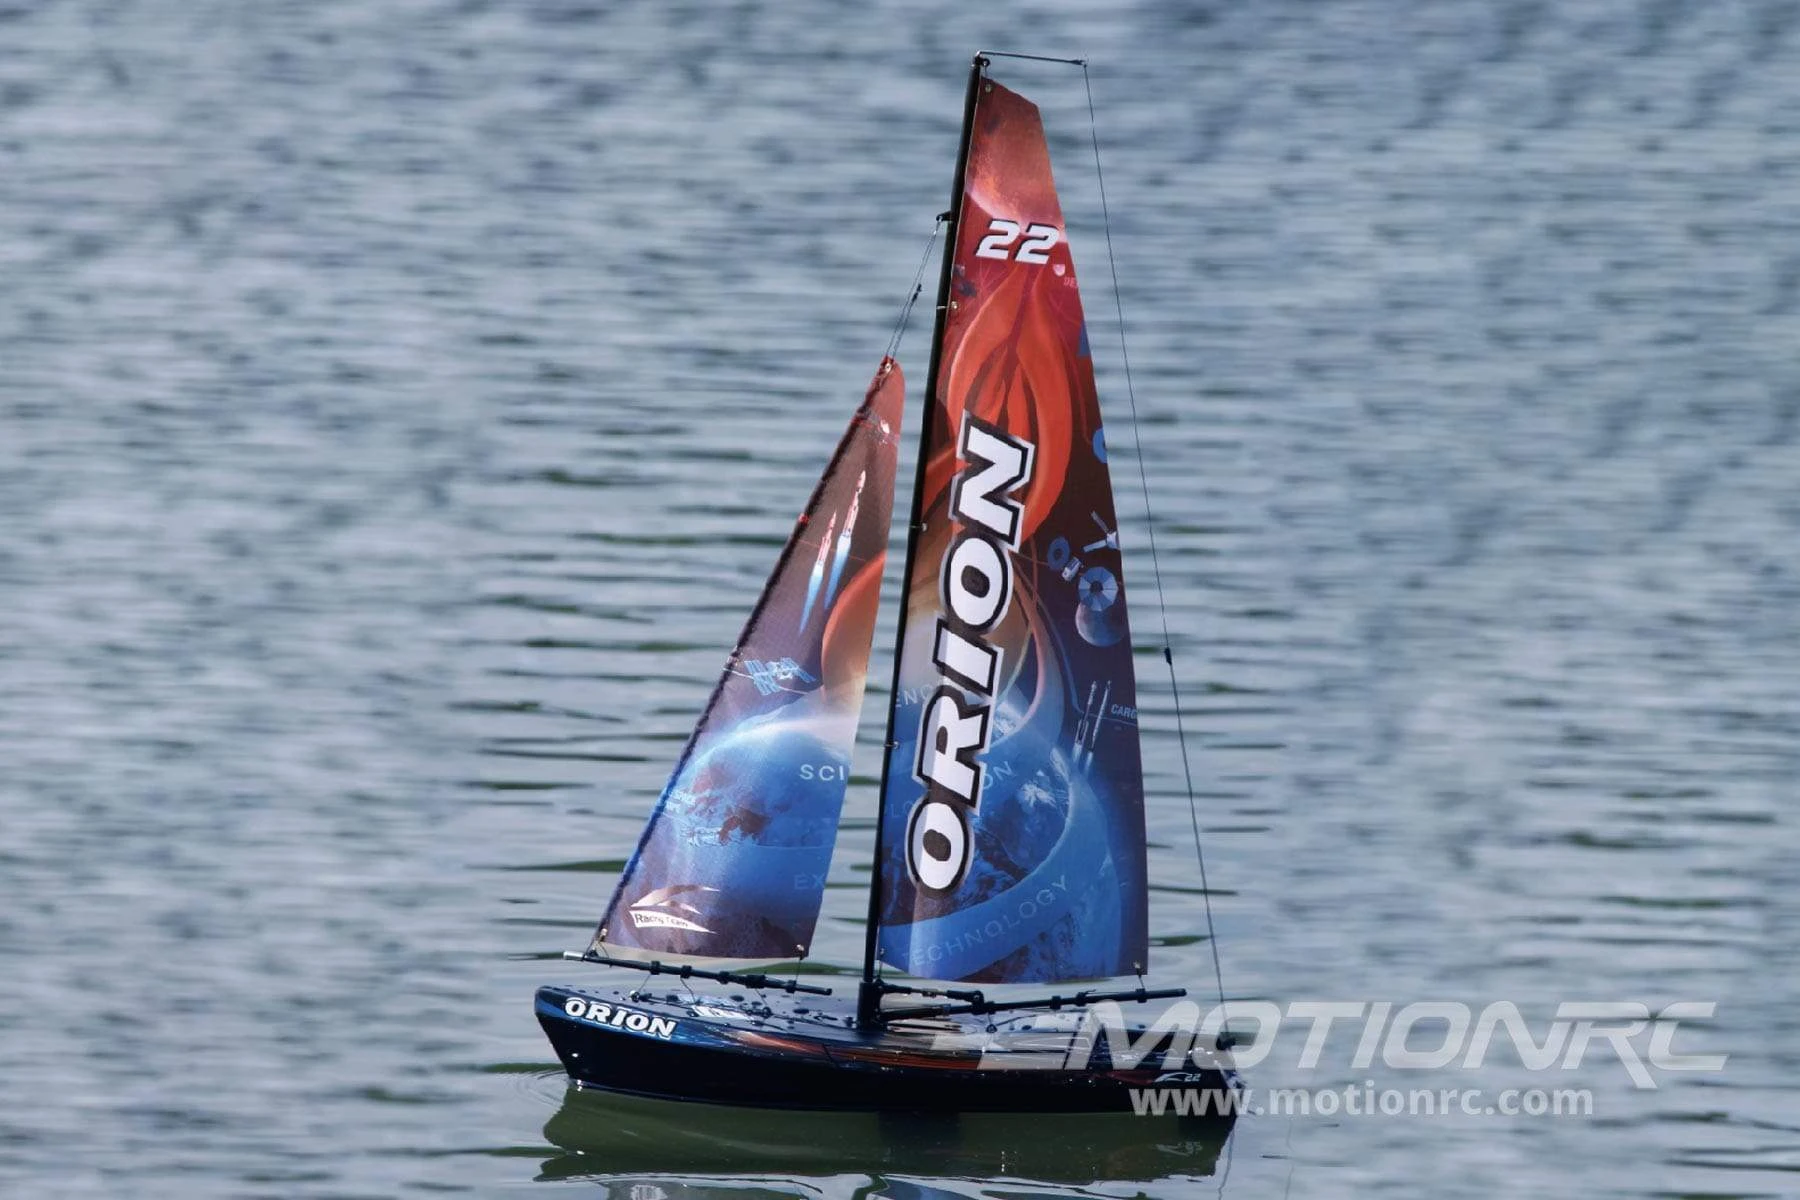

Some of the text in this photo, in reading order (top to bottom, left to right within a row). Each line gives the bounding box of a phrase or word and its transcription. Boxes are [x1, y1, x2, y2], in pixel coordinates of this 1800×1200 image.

[975, 219, 1060, 264] 22
[905, 408, 1035, 892] ORION
[799, 763, 845, 782] SCI
[564, 997, 677, 1040] ORION
